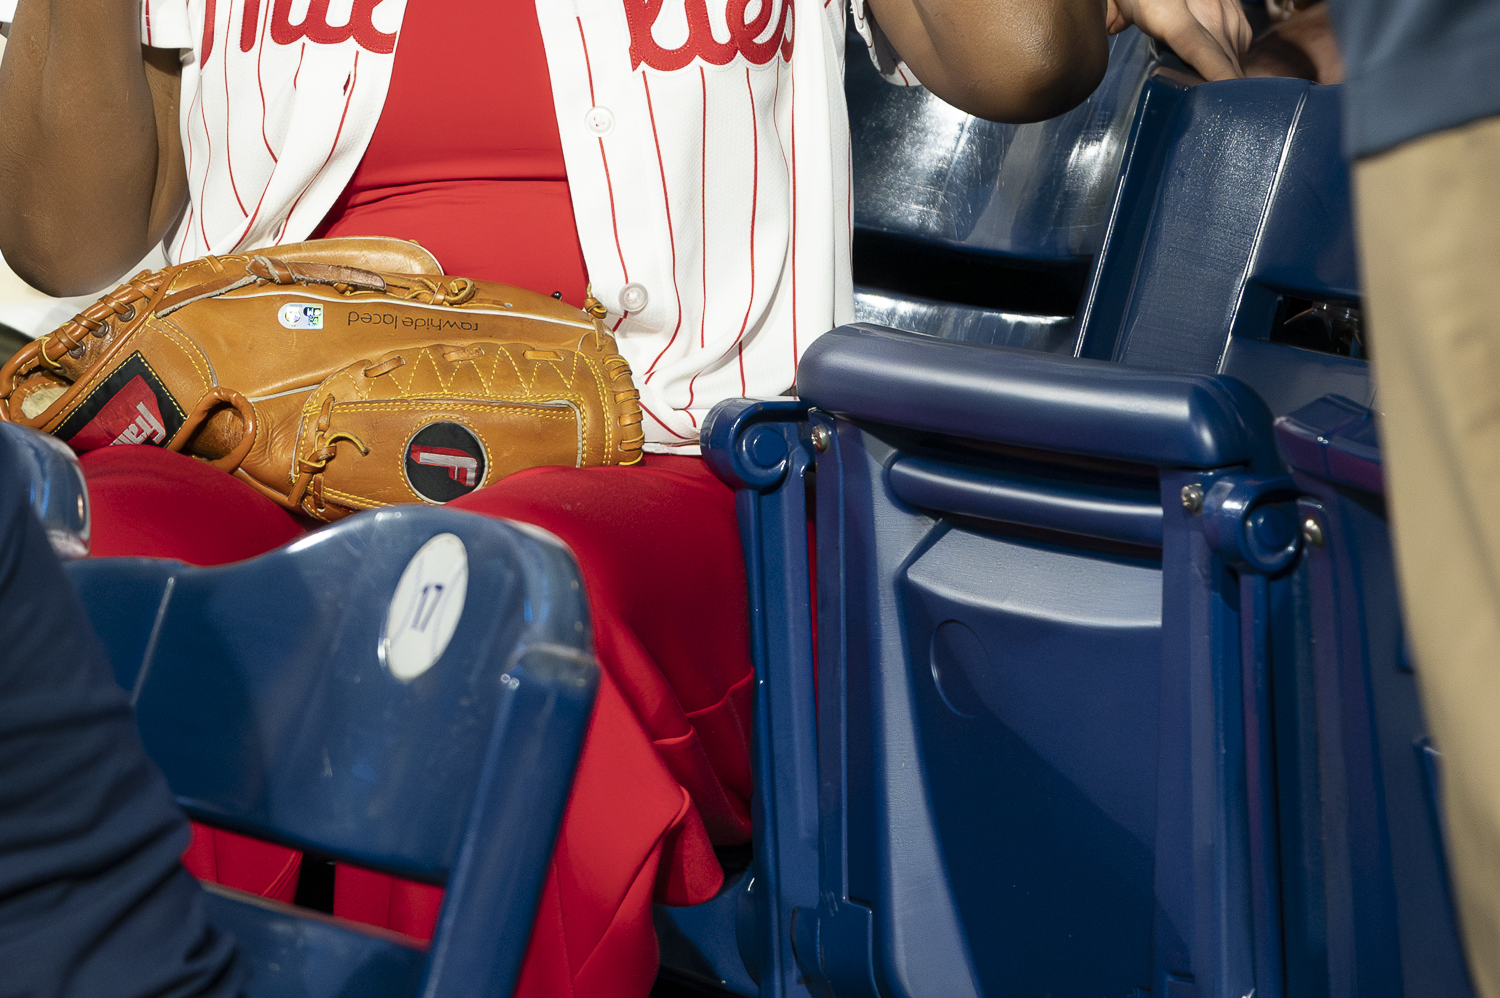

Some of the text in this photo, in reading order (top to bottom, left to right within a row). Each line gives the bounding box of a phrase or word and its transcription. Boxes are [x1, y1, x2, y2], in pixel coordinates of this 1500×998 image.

[347, 310, 479, 331] rawhide laced
[411, 582, 445, 633] 17
